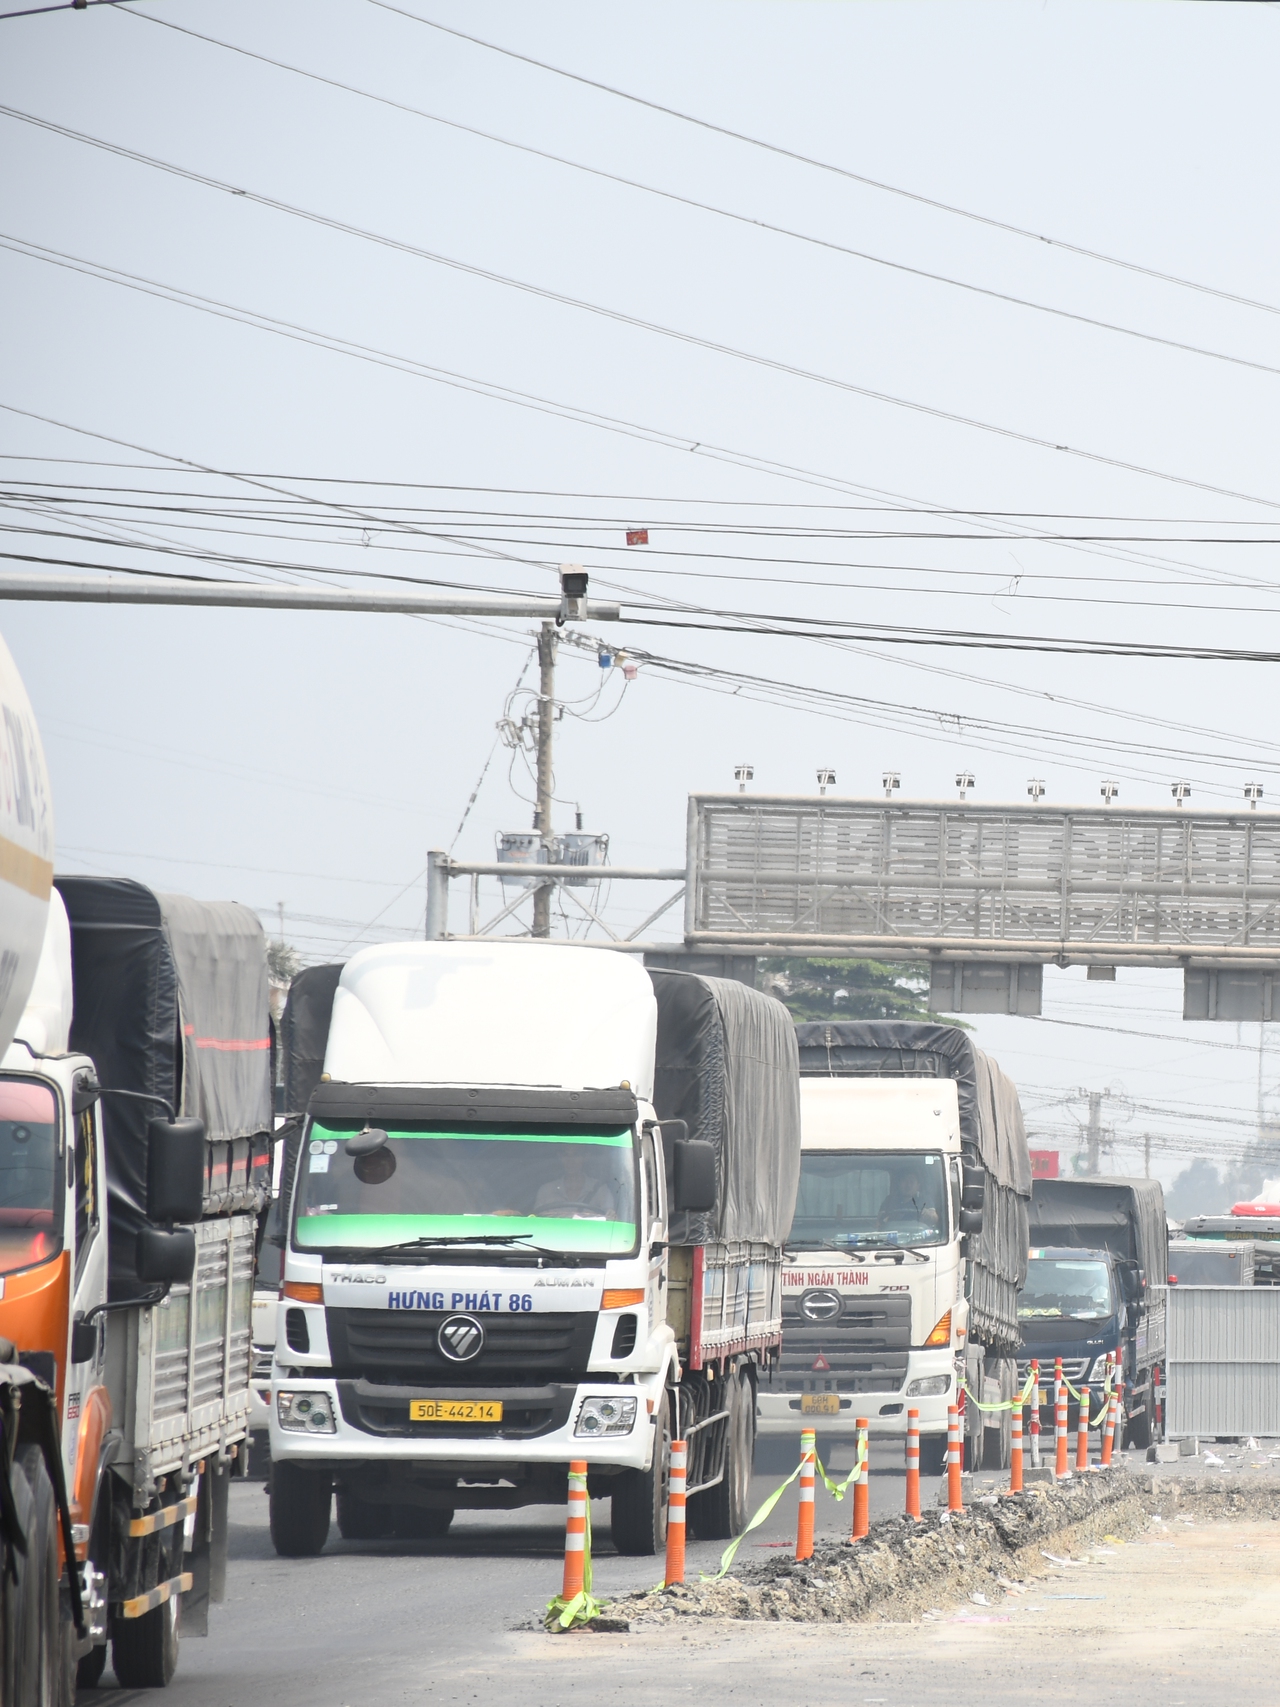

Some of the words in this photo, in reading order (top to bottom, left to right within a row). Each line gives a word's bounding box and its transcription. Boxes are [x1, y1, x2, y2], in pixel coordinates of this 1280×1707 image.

[330, 1272, 387, 1285] THACO
[533, 1277, 595, 1288] AUMAN
[807, 1269, 834, 1286] NGÂN
[837, 1269, 869, 1286] THÀNH
[388, 1289, 444, 1310] HƯNG
[451, 1289, 502, 1312] PHÁT
[508, 1293, 533, 1312] 86
[418, 1404, 494, 1419] 50E-442.14
